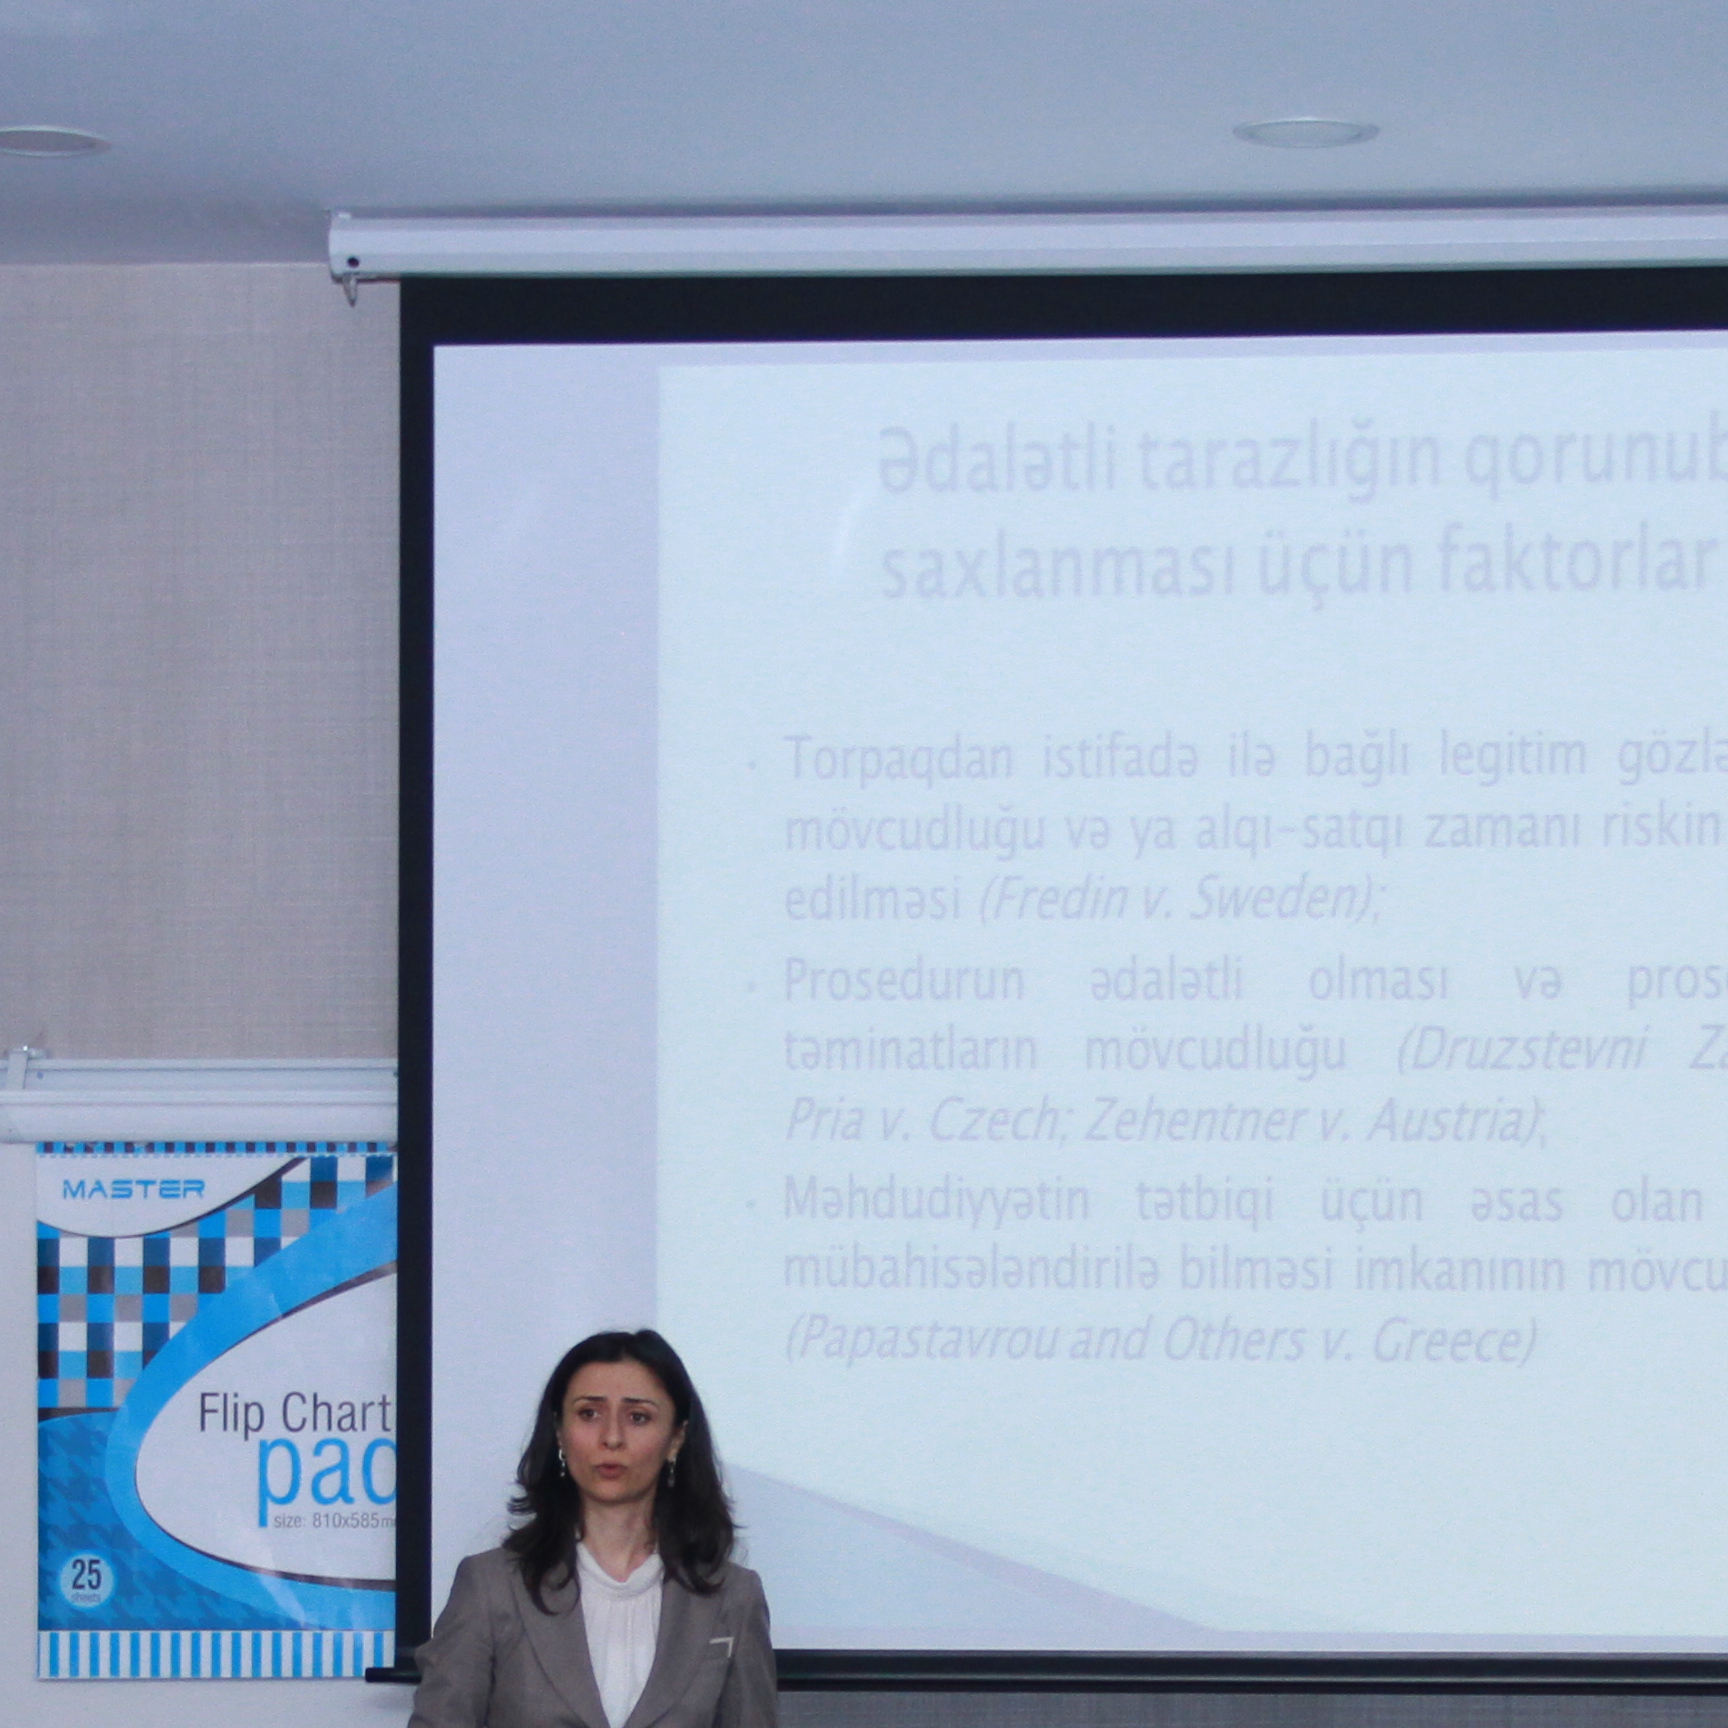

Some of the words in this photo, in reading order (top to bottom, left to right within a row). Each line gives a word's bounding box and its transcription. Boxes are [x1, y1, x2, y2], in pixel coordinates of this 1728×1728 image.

[62, 1178, 205, 1200] MASTER
[200, 1392, 265, 1441] Flip
[282, 1391, 392, 1432] Chart
[71, 1558, 102, 1590] 25
